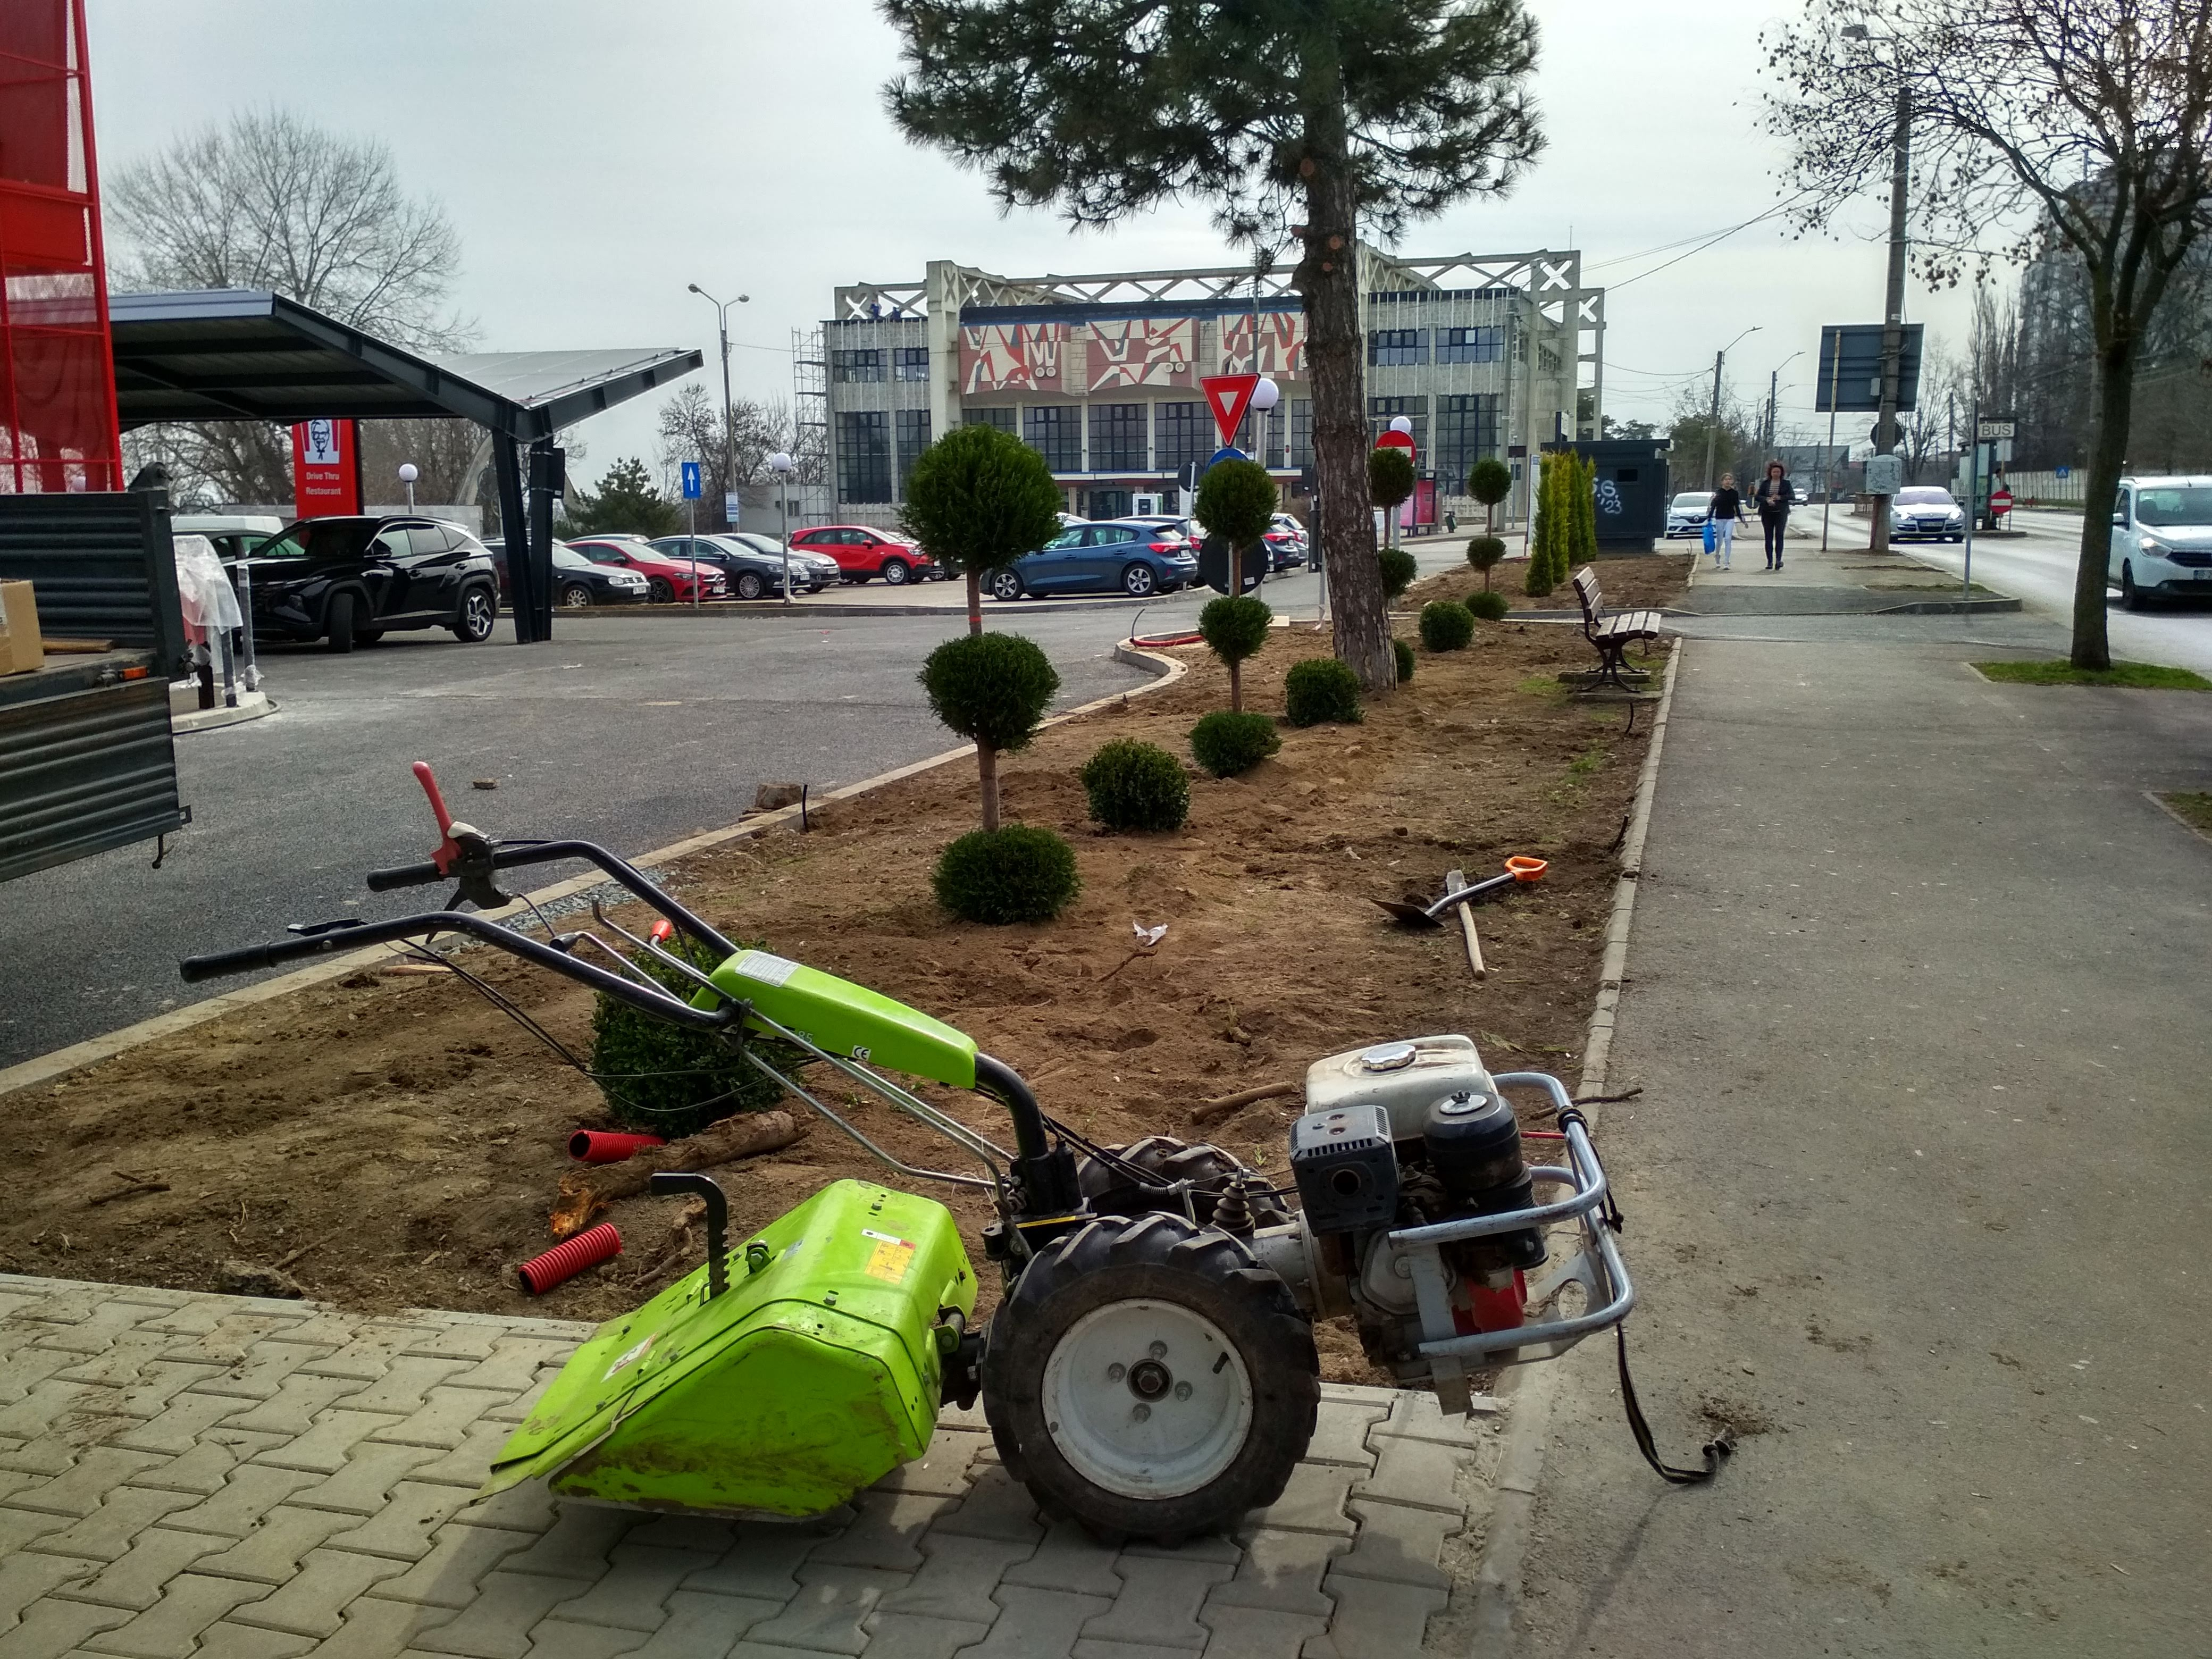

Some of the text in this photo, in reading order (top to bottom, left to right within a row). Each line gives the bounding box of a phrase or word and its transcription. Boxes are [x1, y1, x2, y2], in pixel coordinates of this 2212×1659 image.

[1982, 425, 2011, 436] BUS
[306, 472, 340, 480] Drive Thru
[306, 487, 341, 495] Restaurant
